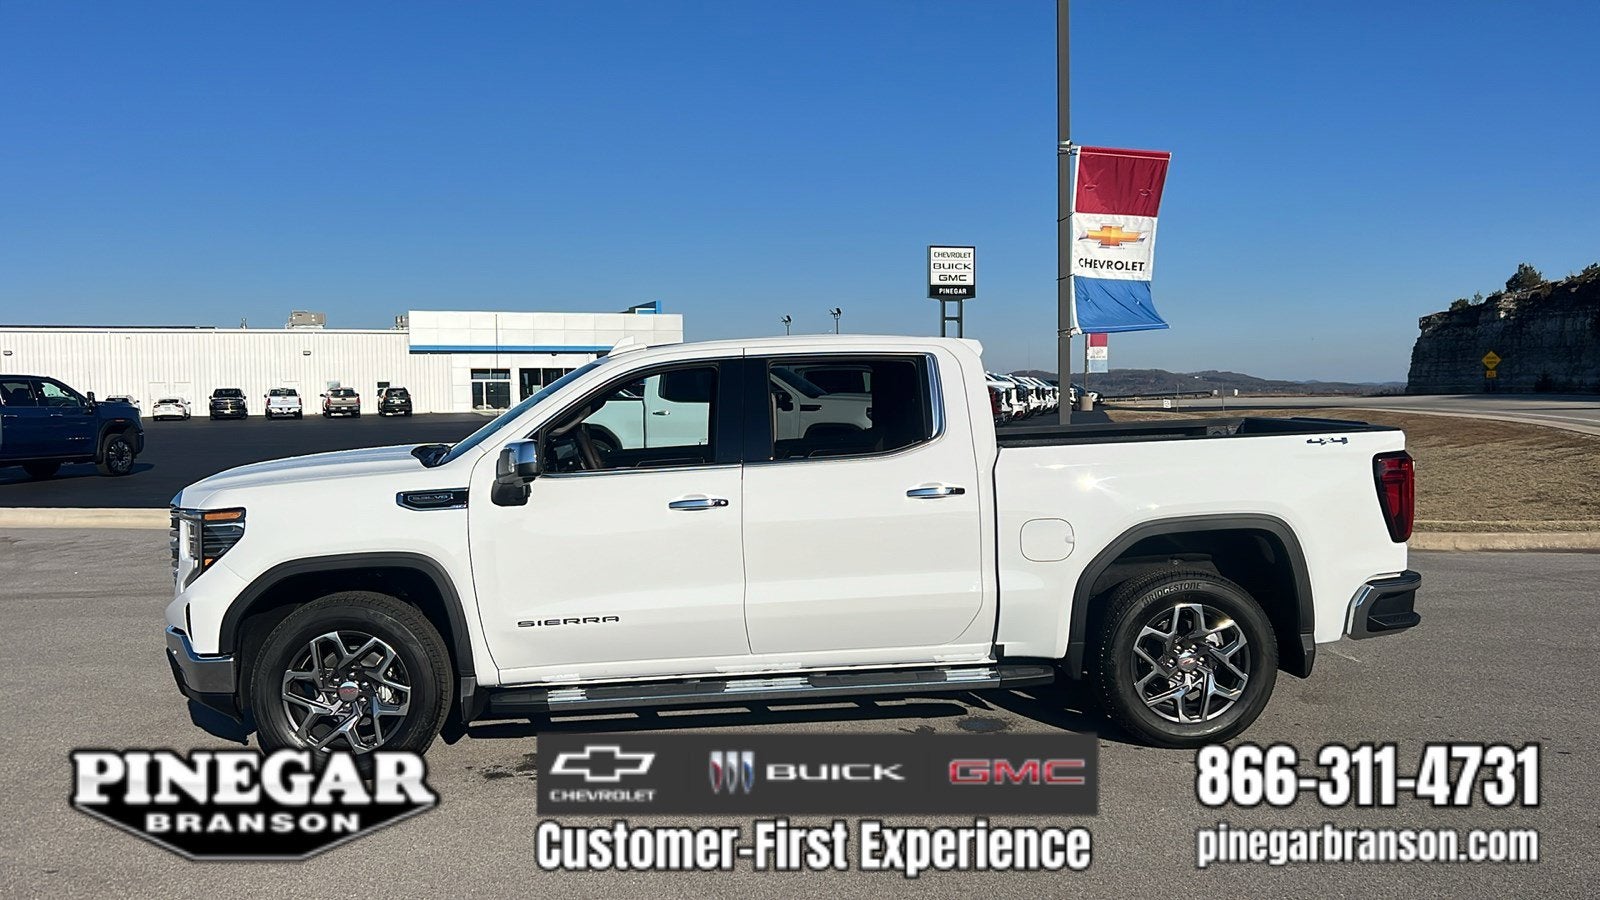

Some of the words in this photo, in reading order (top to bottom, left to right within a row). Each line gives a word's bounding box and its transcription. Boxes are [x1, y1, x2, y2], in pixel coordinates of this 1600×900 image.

[933, 251, 971, 259] CHEVROLET
[1078, 257, 1145, 272] CHEVROLET
[1140, 581, 1203, 607] BRIDGESTONE
[517, 615, 620, 628] SIERRA
